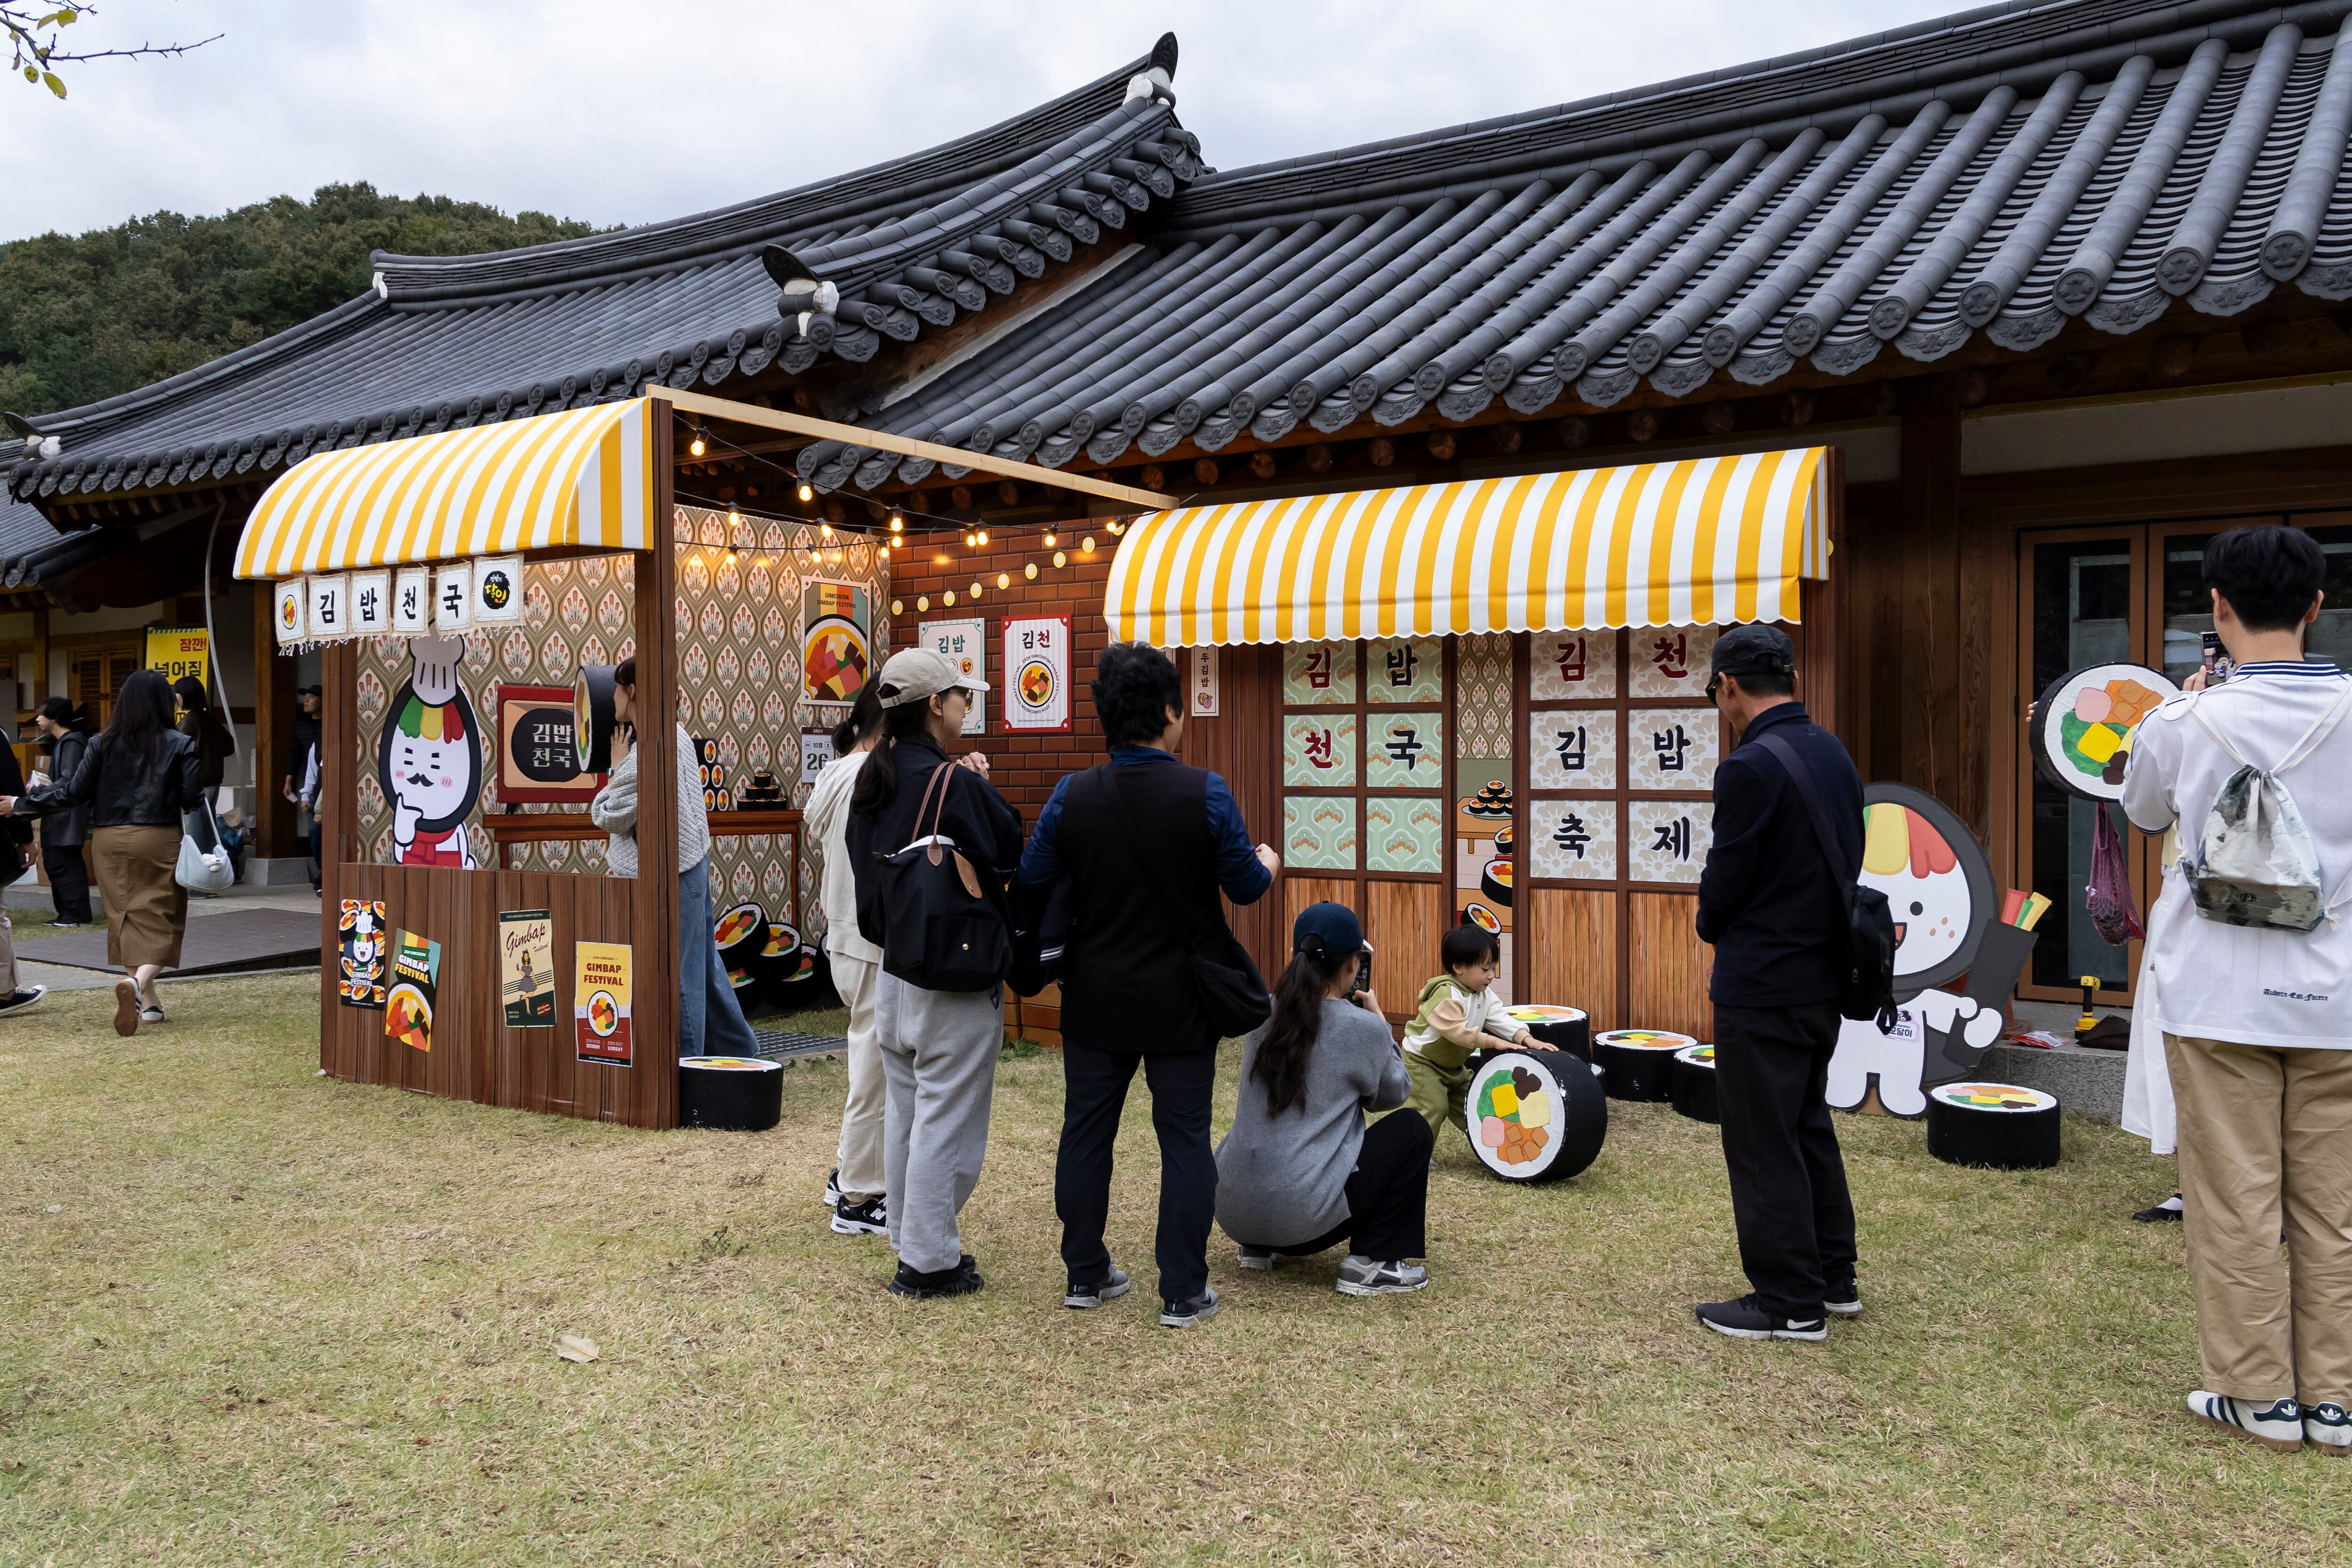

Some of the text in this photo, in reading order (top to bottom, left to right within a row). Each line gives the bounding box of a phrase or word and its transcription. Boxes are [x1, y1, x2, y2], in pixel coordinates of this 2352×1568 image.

[484, 583, 507, 603] 달인
[180, 638, 207, 652] 잠깐!
[938, 634, 966, 654] 김밥
[1022, 630, 1050, 649] 김천
[155, 660, 202, 678] 넘어짐
[1031, 654, 1051, 664] GIMCHEON
[1051, 664, 1059, 681] GIMBAP
[1201, 647, 1210, 687] 두김밥
[532, 724, 573, 744] 김밥
[532, 748, 572, 768] 천국
[807, 753, 828, 770] 26
[506, 923, 547, 958] Gimbap
[395, 962, 429, 984] FESTIVAL
[399, 955, 429, 972] GIMBAP
[587, 963, 621, 973] GIMBAP
[351, 979, 373, 987] FESTIVAL
[584, 975, 624, 986] FESTIVAL
[870, 1208, 886, 1220] N
